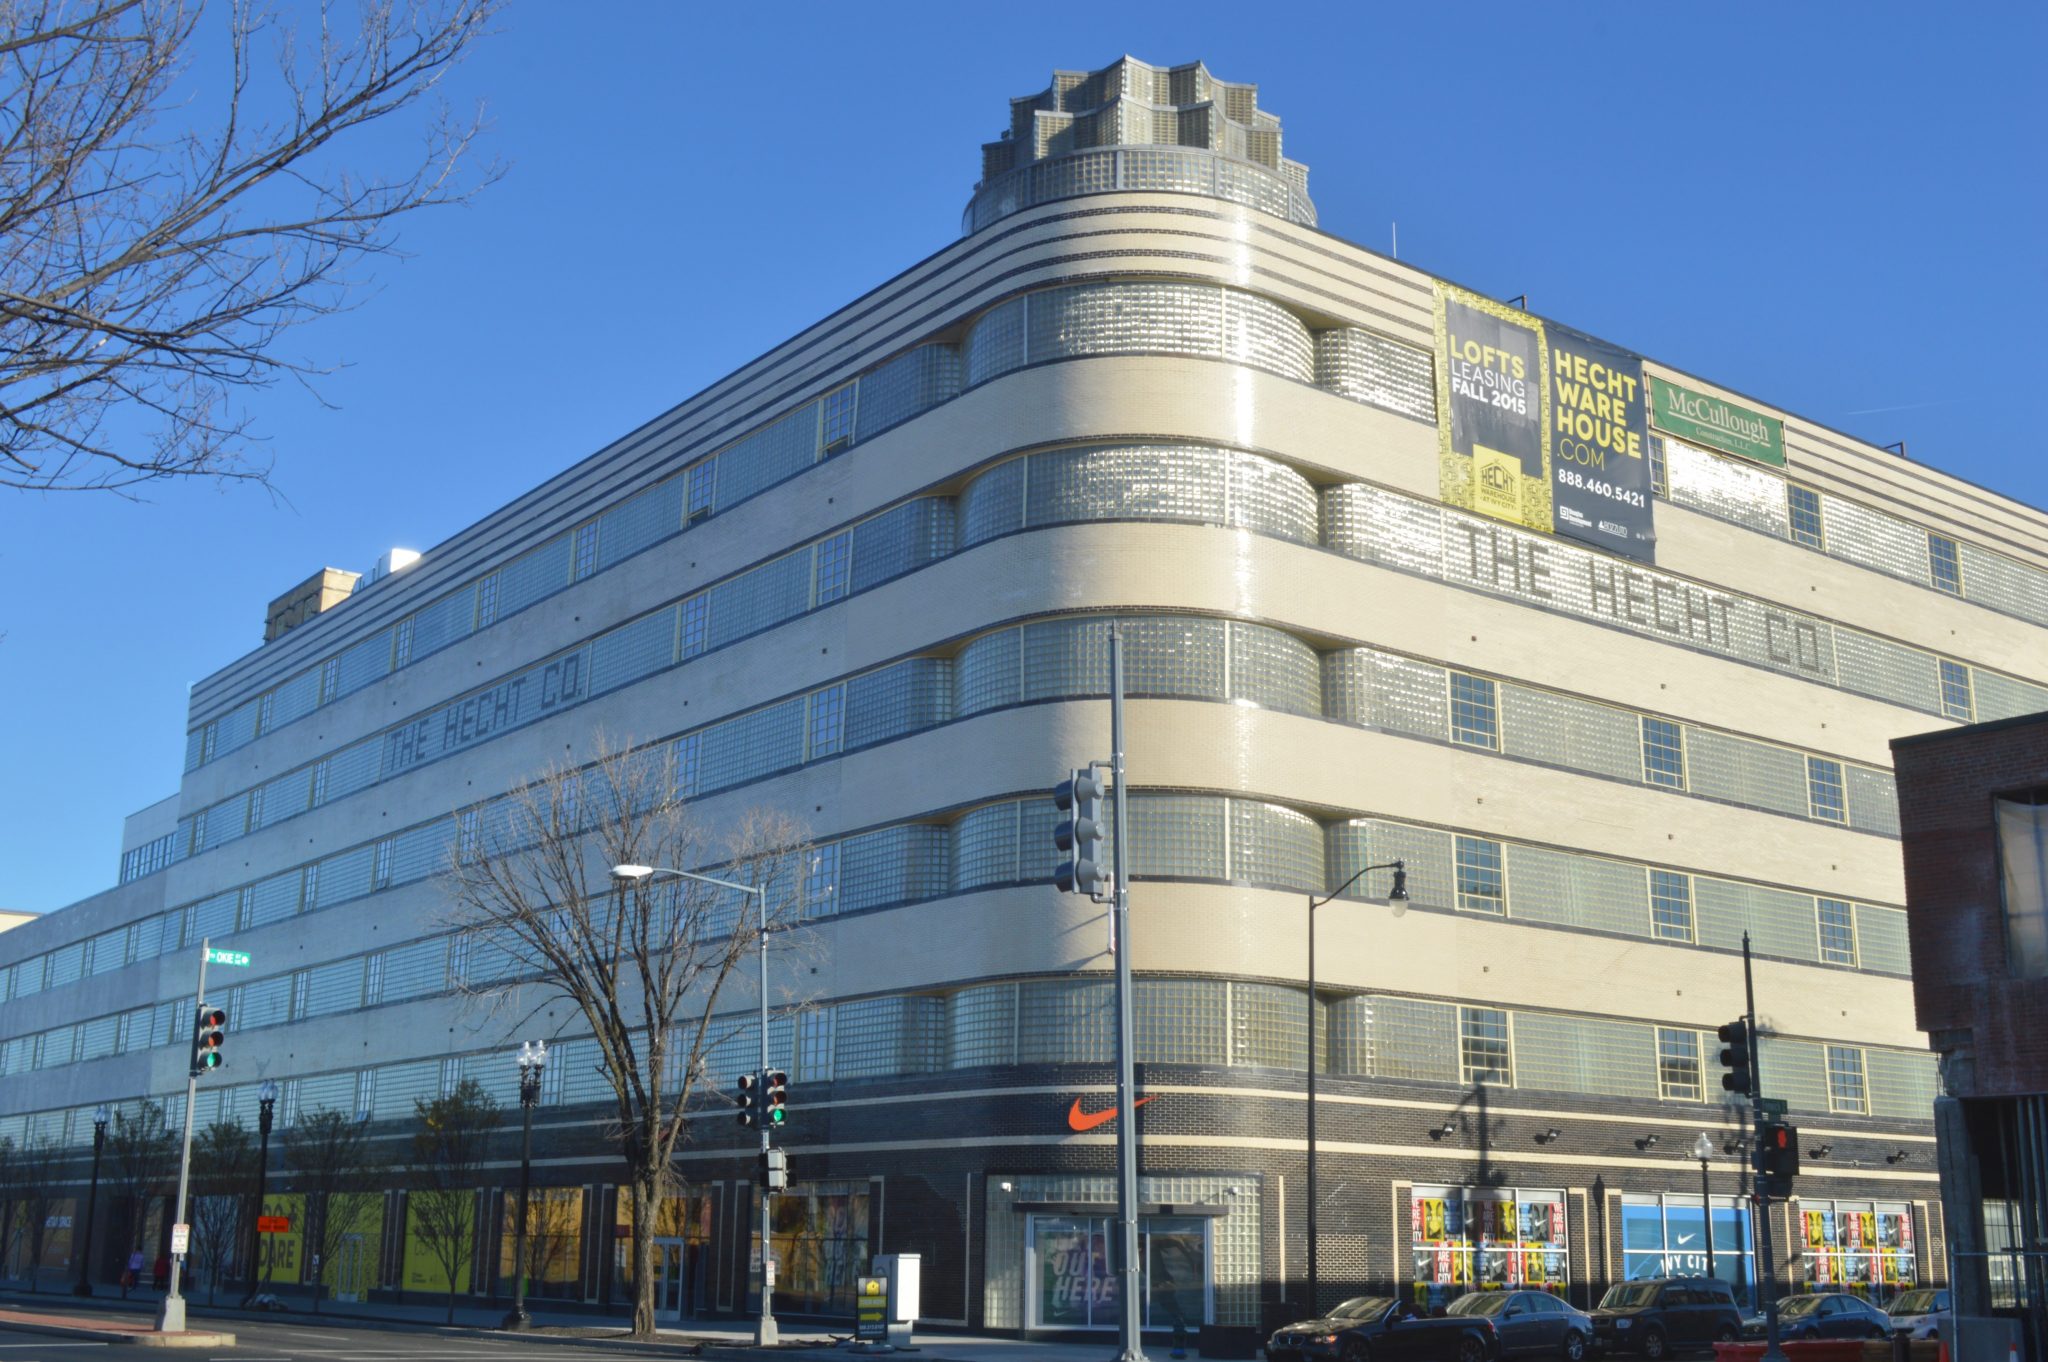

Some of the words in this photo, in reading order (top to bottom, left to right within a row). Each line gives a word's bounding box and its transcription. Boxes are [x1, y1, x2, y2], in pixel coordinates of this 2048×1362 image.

[1450, 334, 1525, 379] LOFTS
[1451, 358, 1525, 398] LEASING
[1555, 348, 1637, 403] HECHT
[1452, 376, 1488, 403] FALL
[1491, 389, 1526, 415] 2015
[1555, 376, 1626, 427] WARE
[1667, 388, 1769, 443] McCullough
[1557, 405, 1642, 459] HOUSE
[1481, 465, 1514, 493] HECHT
[1558, 468, 1645, 508] 888.460.5421
[1457, 522, 1553, 600] THE
[1590, 557, 1734, 650] HECHT
[390, 718, 430, 771] THE
[443, 676, 526, 750] HECHT
[1053, 1276, 1116, 1302] HERE
